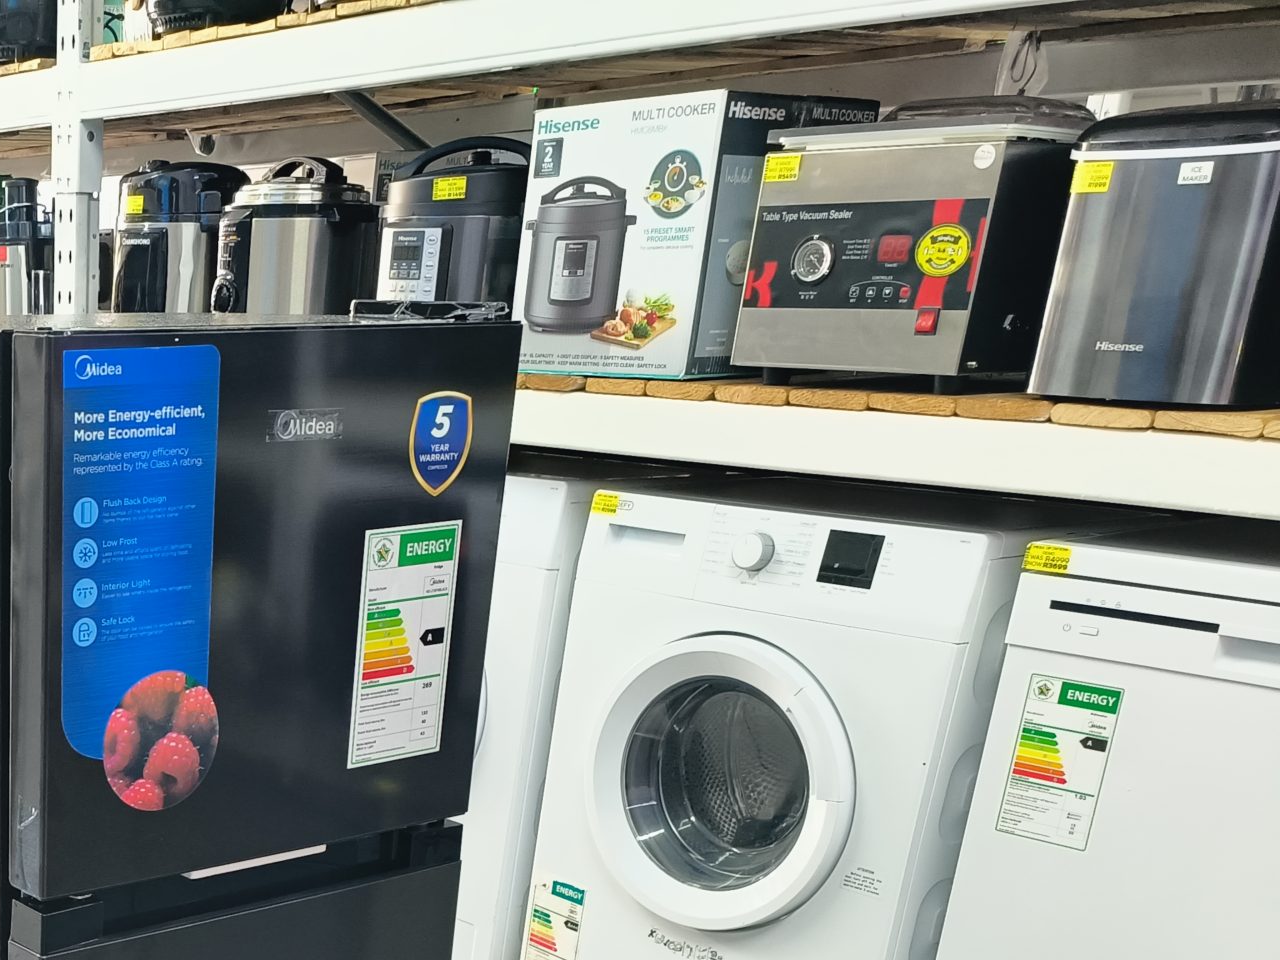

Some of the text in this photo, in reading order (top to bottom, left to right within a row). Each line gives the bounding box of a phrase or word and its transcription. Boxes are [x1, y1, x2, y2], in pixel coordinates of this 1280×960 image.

[632, 102, 716, 121] MULTI COOKER
[728, 101, 786, 121] Hisense
[812, 108, 875, 123] MULTI COOKER
[537, 118, 600, 135] Hisense
[544, 147, 553, 162] 2
[1190, 166, 1203, 174] ICE
[1181, 175, 1209, 183] MAKER
[762, 209, 853, 223] Table Type Vacuum Sealer
[650, 227, 673, 235] PRESET
[674, 226, 695, 234] SMART
[646, 234, 690, 242] PROGRAMMES
[1095, 340, 1144, 352] Hisense
[73, 404, 206, 424] More Energy-efficient,
[277, 410, 334, 440] Midea
[430, 405, 454, 438] 5
[73, 423, 176, 442] More Economical
[73, 447, 189, 463] Remarkable energy efficiency
[430, 444, 449, 452] YEAR
[419, 452, 458, 462] WARRANTY
[73, 464, 122, 475] represented
[123, 462, 134, 472] by
[135, 460, 149, 470] the
[150, 458, 170, 469] Class
[172, 458, 179, 466] A
[102, 495, 167, 508] Flush Back Design
[102, 537, 138, 548] Low Frost
[406, 538, 452, 557] ENERGY
[1043, 562, 1068, 570] R3699
[101, 579, 151, 591] Interior Light
[101, 615, 135, 626] Safe Lock
[427, 633, 433, 642] A
[1066, 689, 1117, 707] ENERGY
[555, 884, 583, 900] ENERGY
